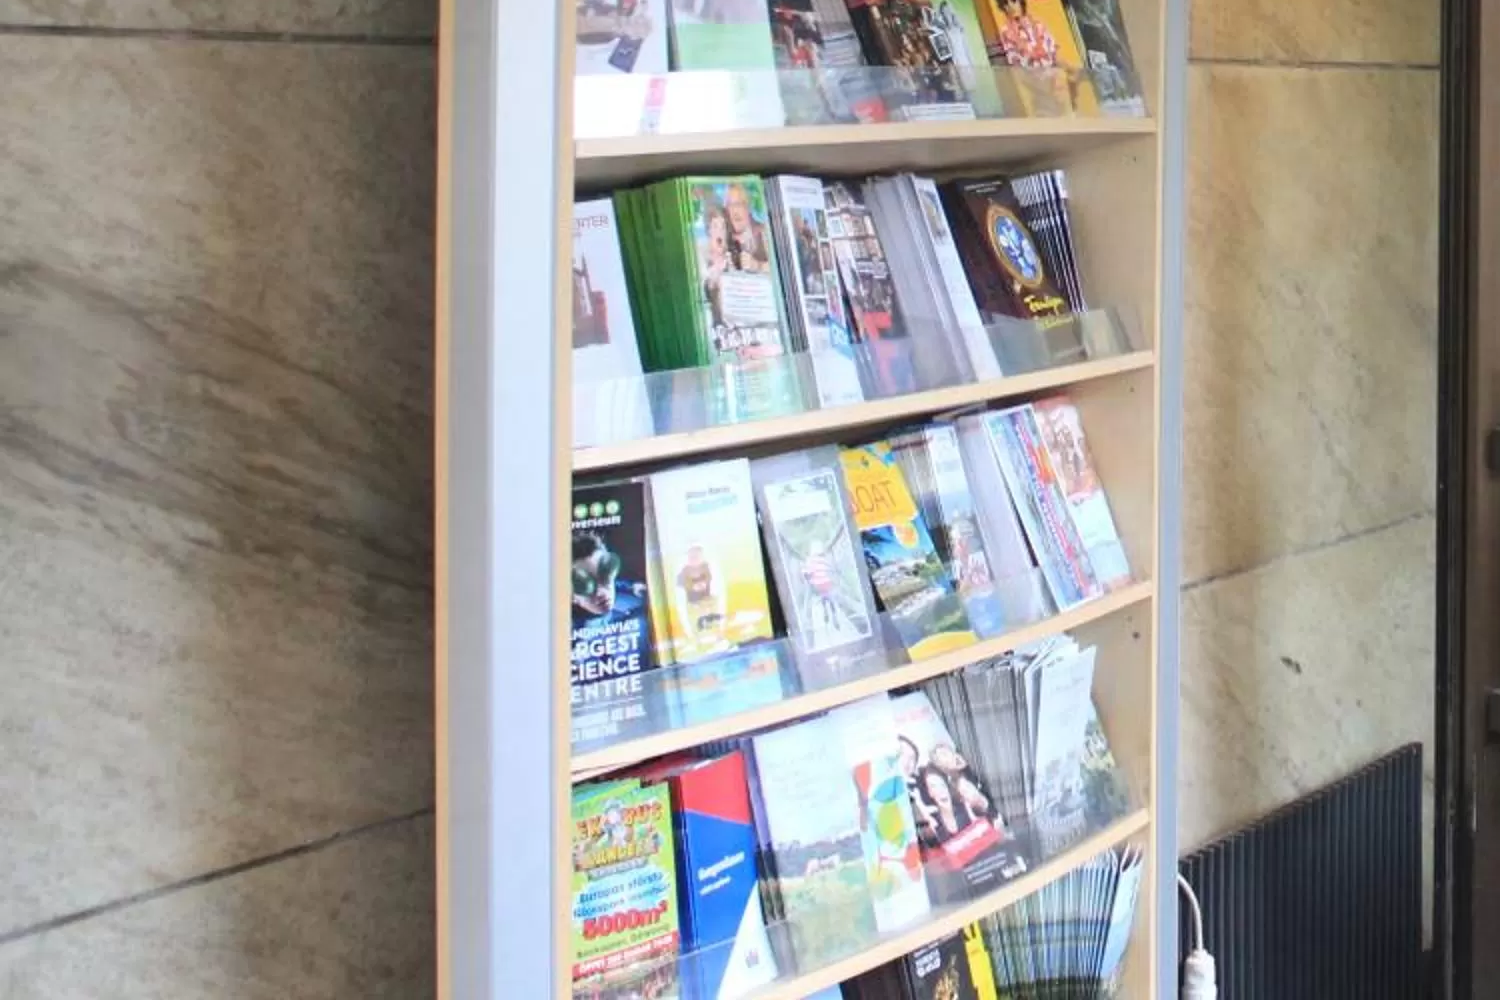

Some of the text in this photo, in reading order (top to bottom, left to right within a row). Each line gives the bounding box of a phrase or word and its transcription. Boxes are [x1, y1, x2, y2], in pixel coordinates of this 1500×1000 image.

[571, 618, 640, 642] NDINAVIA'S
[571, 634, 641, 660] RGEST
[571, 654, 641, 684] CIENCE
[571, 674, 643, 700] ENTRE
